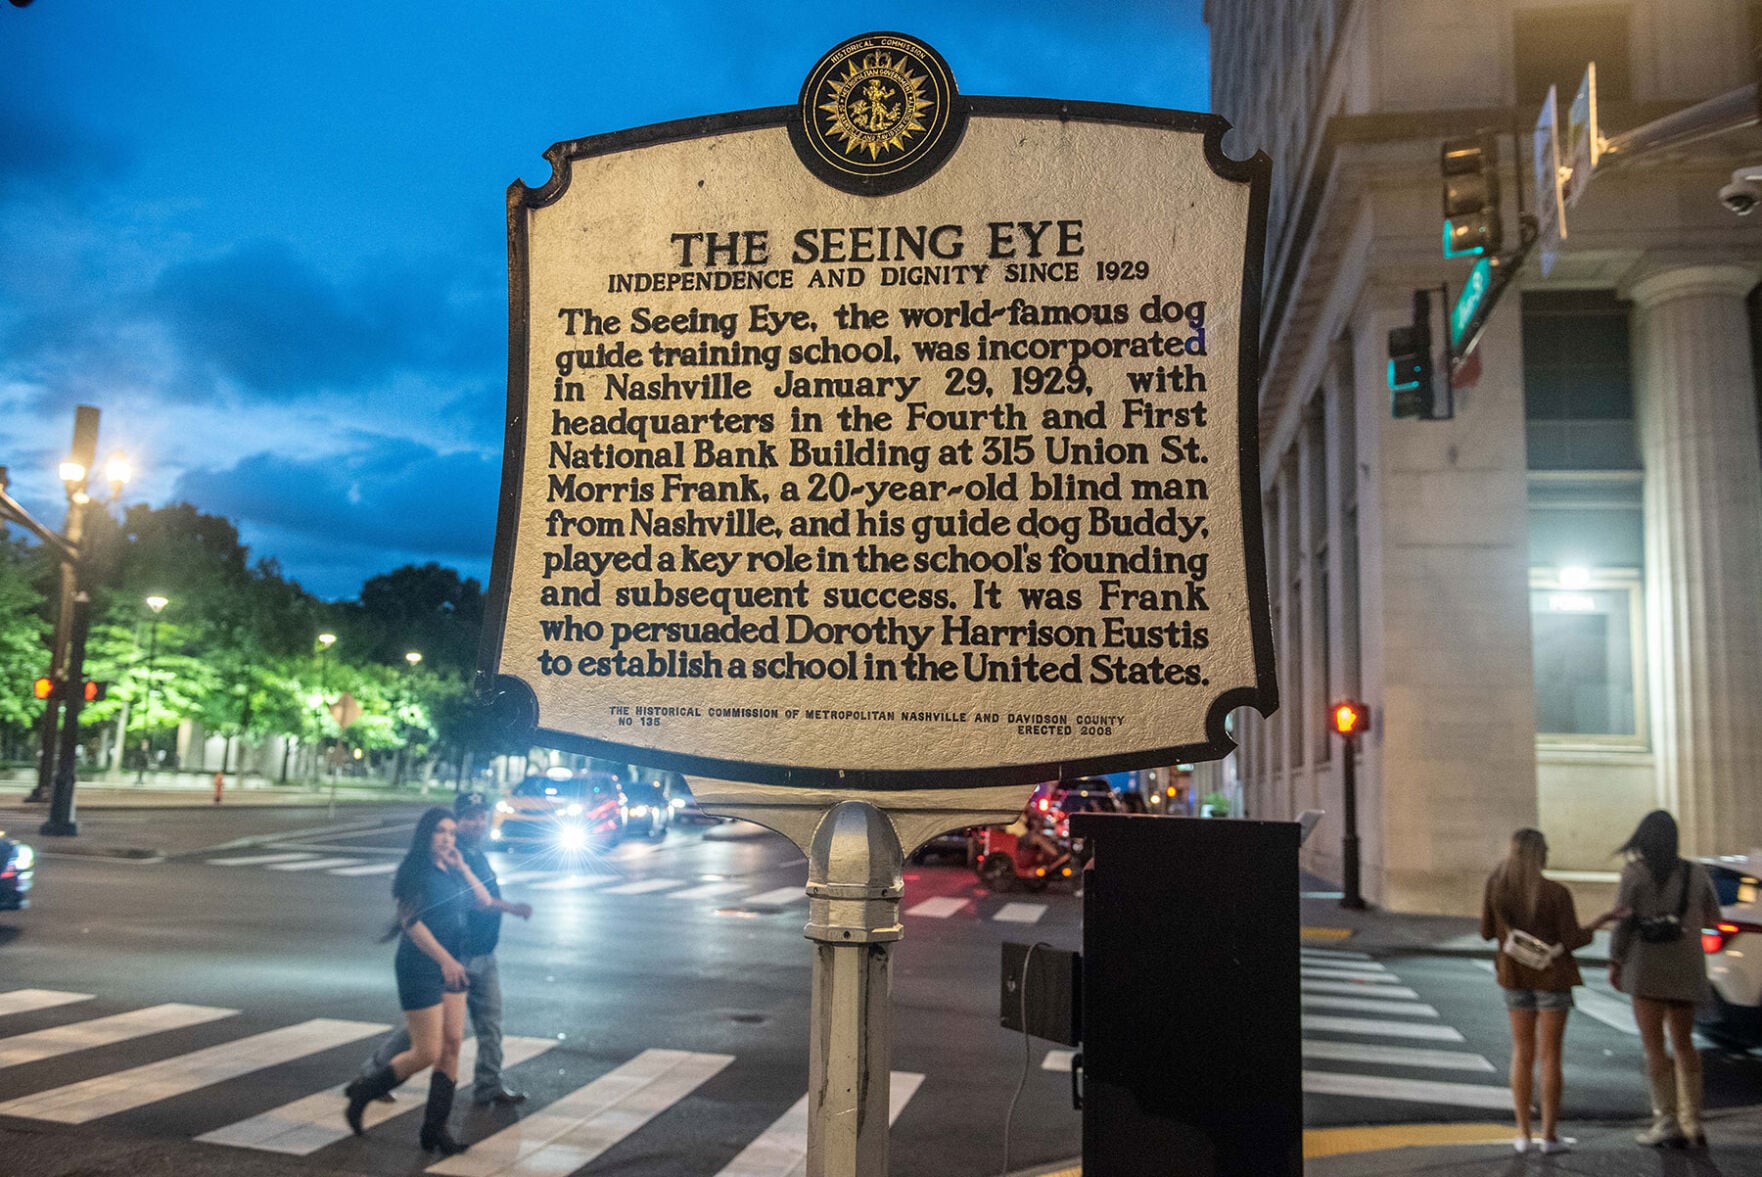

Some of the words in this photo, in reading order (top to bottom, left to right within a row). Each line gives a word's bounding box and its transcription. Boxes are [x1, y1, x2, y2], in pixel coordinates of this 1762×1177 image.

[830, 40, 874, 63] HISTORICAL
[881, 39, 926, 59] COMMISSION
[671, 230, 768, 267] THE
[792, 225, 964, 264] SEEING
[986, 220, 1084, 259] EYE
[608, 270, 793, 293] INDEPENDENCE
[808, 268, 865, 288] AND
[881, 264, 990, 286] DIGNITY
[1005, 262, 1079, 283] SINCE
[1097, 261, 1149, 281] 1929
[558, 308, 620, 336] The
[631, 308, 738, 339] Seeing
[748, 304, 817, 336] Eye,
[833, 303, 889, 330] the
[899, 298, 1129, 328] world-famous
[1140, 295, 1208, 328] dog
[556, 342, 643, 376] guide
[649, 341, 781, 371] training
[789, 336, 900, 365] school,
[912, 341, 970, 362] was
[977, 328, 1208, 366] incorporated
[554, 377, 585, 402] in
[604, 373, 751, 401] Nashville
[774, 370, 921, 402] January
[945, 367, 993, 398] 29,
[1012, 366, 1092, 396] 1929,
[1126, 364, 1207, 393] with
[551, 408, 774, 442] headquarters
[791, 406, 823, 432] in
[837, 405, 892, 431] the
[906, 402, 1027, 431] Fourth
[1042, 400, 1107, 429] and
[1122, 398, 1207, 428] First
[549, 441, 685, 468] National
[693, 439, 778, 468] Bank
[789, 438, 931, 473] Building
[939, 439, 973, 465] at
[982, 435, 1035, 465] 315
[1045, 437, 1149, 465] Union
[1161, 435, 1208, 464] St.
[547, 474, 654, 502] Morris
[661, 474, 769, 503] Frank,
[780, 482, 800, 501] a
[807, 472, 1018, 508] 20-year-old
[1030, 472, 1122, 500] blind
[1131, 479, 1209, 500] man
[545, 509, 625, 537] from
[630, 508, 783, 538] Nashville,
[789, 509, 850, 537] and
[856, 509, 904, 536] his
[912, 508, 1010, 544] guide
[1017, 508, 1082, 545] dog
[1088, 507, 1208, 543] Buddy,
[542, 545, 653, 579] played
[657, 552, 676, 572] a
[681, 544, 742, 577] key
[747, 544, 812, 572] role
[816, 547, 849, 572] in
[853, 545, 909, 572] the
[914, 542, 1041, 573] school's
[1048, 545, 1209, 581] founding
[541, 579, 601, 606] and
[616, 579, 809, 615] subsequent
[824, 588, 956, 609] success.
[973, 579, 1001, 609] It
[1018, 588, 1082, 610] was
[1099, 580, 1209, 611] Frank
[540, 615, 603, 641] who
[610, 615, 781, 650] persuaded
[786, 615, 935, 652] Dorothy
[941, 615, 1097, 648] Harrison
[1102, 617, 1209, 650] Eustis
[537, 650, 572, 676] to
[578, 649, 723, 678] establish
[728, 658, 747, 678] a
[753, 651, 858, 680] school
[864, 653, 897, 681] in
[901, 653, 958, 681] the
[963, 652, 1082, 683] United
[1090, 655, 1209, 686] States.
[610, 707, 629, 715] THE
[636, 706, 701, 716] HISTORICAL
[709, 708, 778, 718] COMMISSION
[785, 710, 799, 718] OF
[806, 710, 894, 720] METROPOLITAN
[902, 712, 966, 722] NASHVILLE
[975, 713, 999, 722] AND
[1008, 714, 1066, 724] DAVIDSON
[1076, 715, 1124, 725] COUNTY
[1018, 725, 1071, 735] ERECTED
[1081, 726, 1111, 735] 2008
